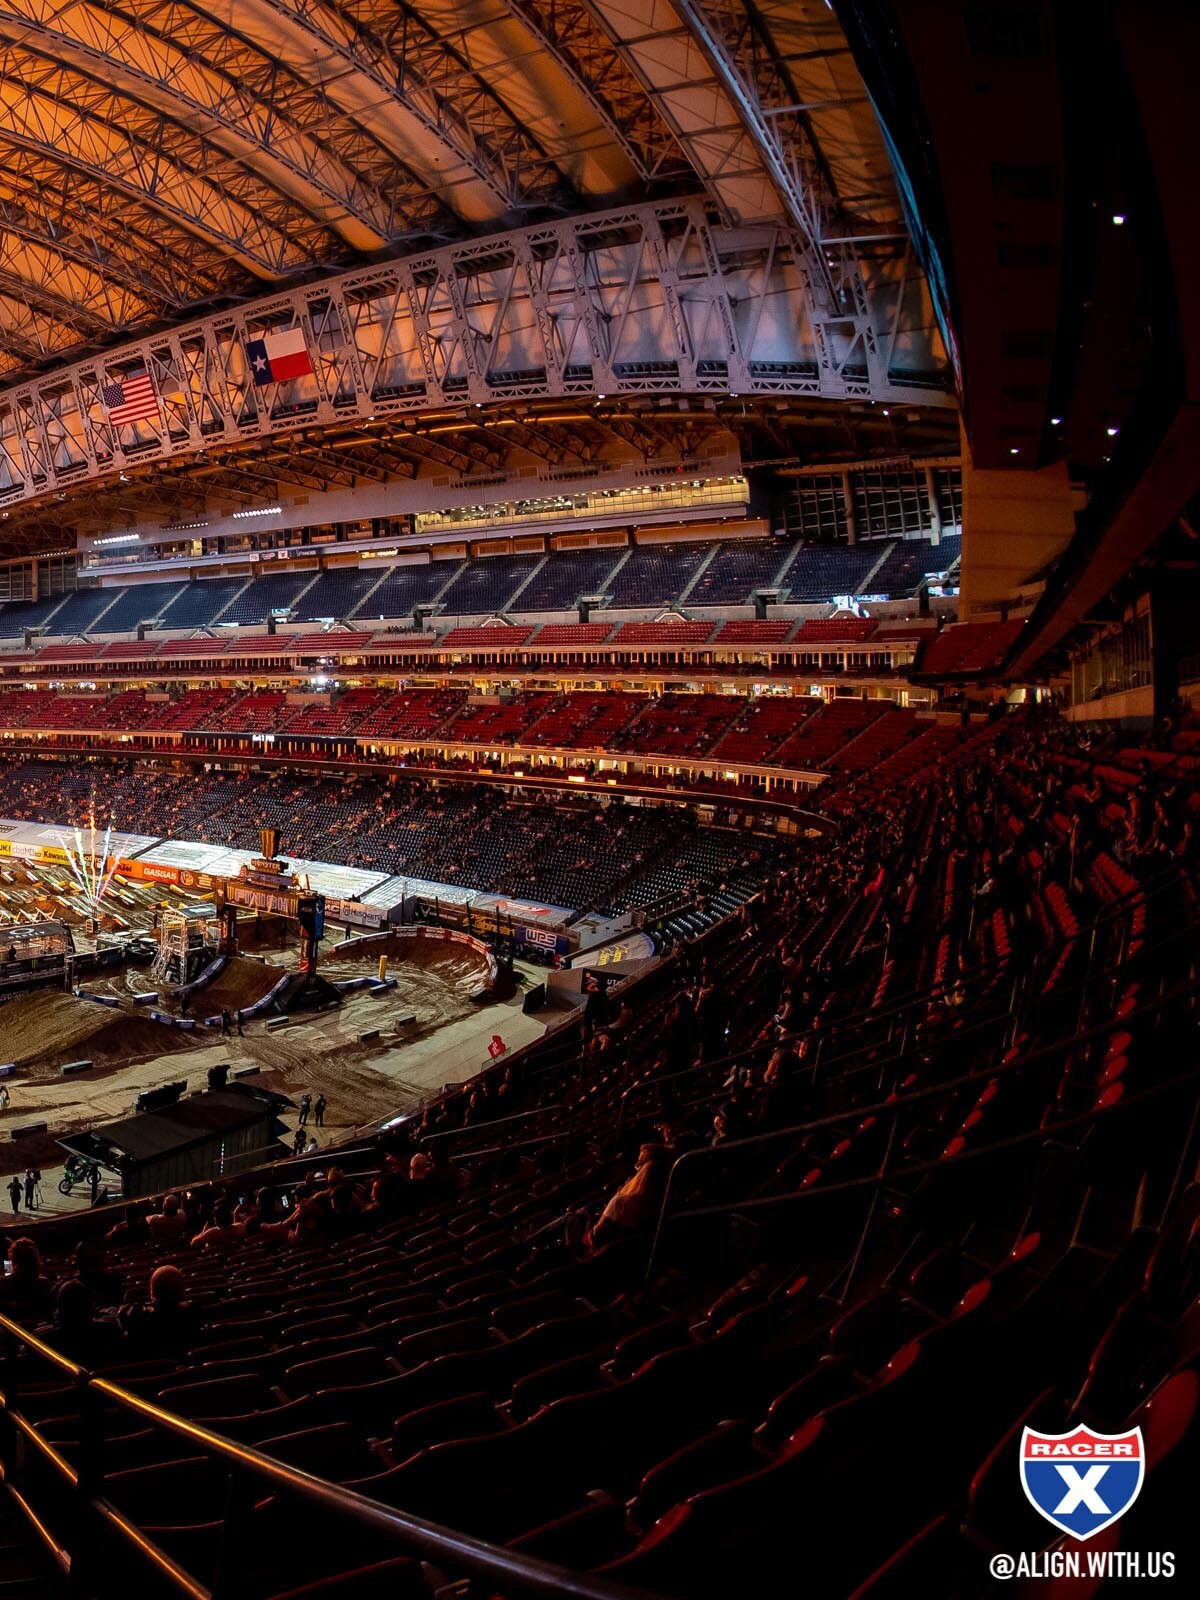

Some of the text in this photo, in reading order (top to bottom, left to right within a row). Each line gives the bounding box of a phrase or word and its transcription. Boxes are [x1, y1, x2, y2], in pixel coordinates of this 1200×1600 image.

[43, 851, 73, 862] Kawasa
[143, 867, 177, 880] GASGAS
[234, 888, 289, 914] FINISH
[525, 928, 557, 947] WPS
